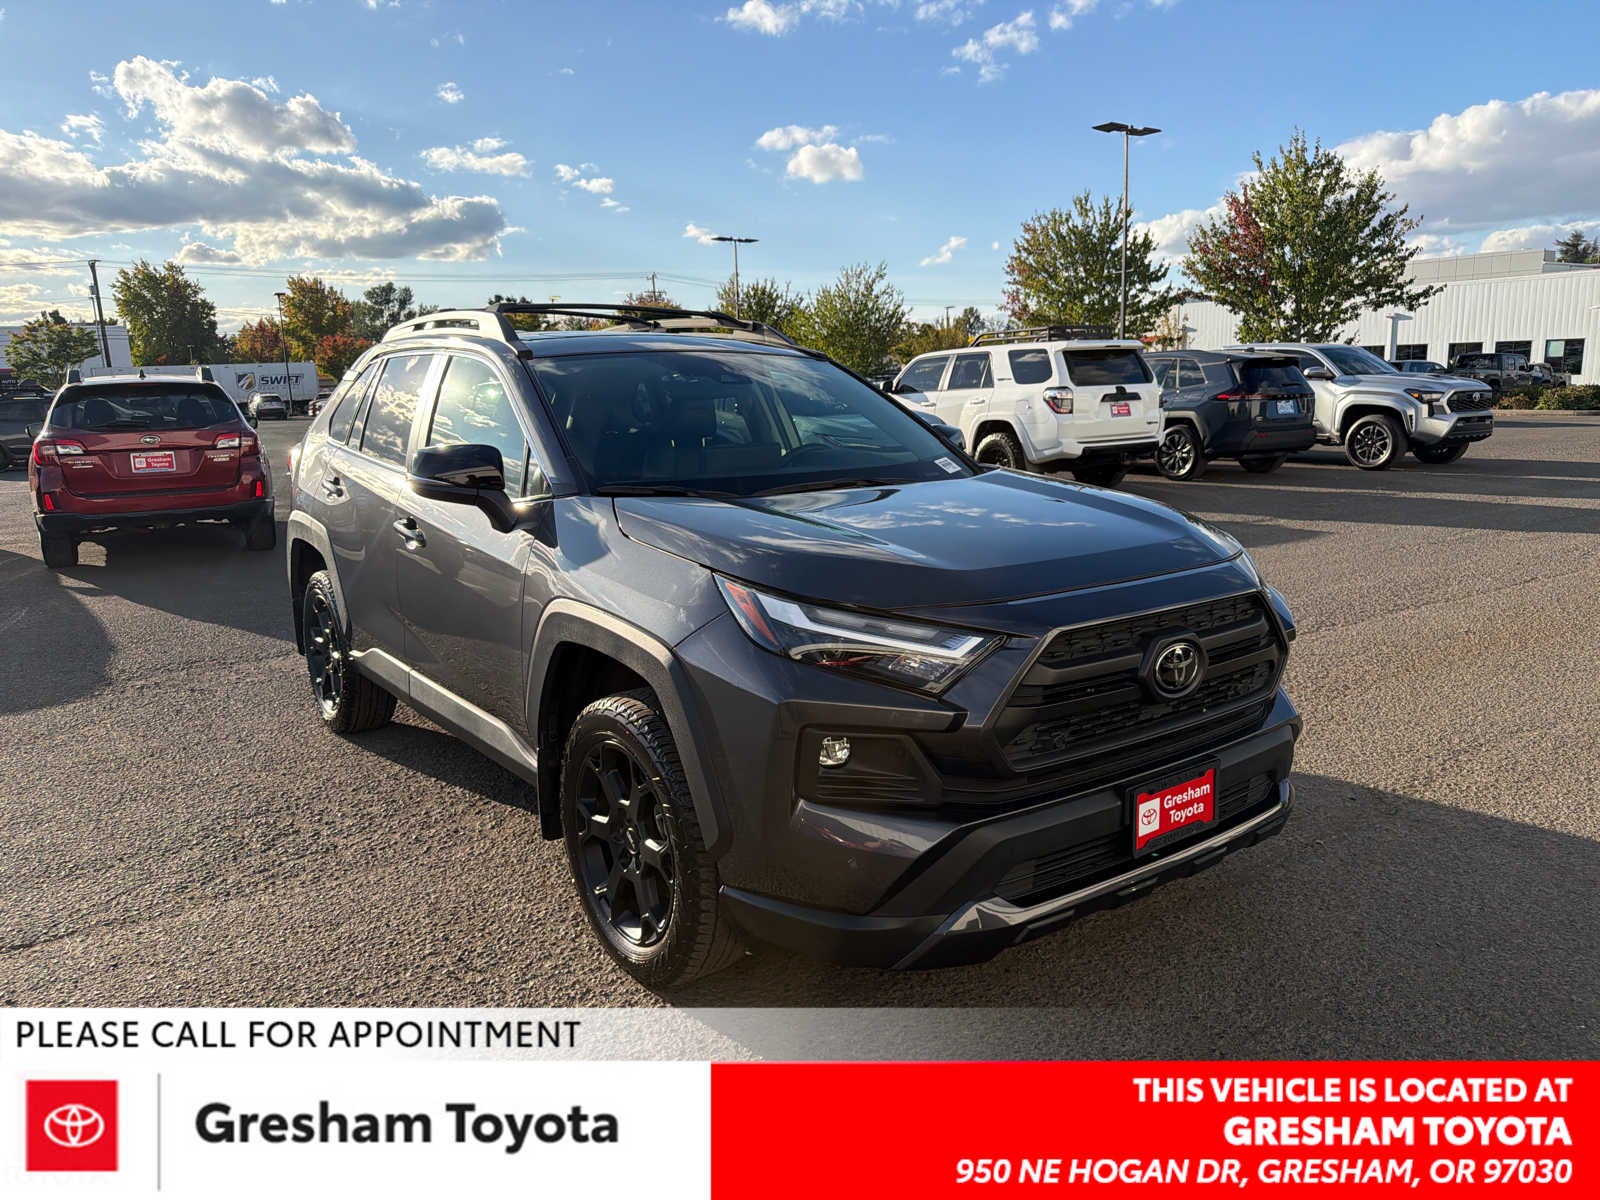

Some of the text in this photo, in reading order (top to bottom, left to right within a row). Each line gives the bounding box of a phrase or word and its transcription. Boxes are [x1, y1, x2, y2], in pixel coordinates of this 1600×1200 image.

[261, 375, 302, 385] SWIFT
[1163, 784, 1210, 808] Gresham
[1168, 802, 1205, 823] Toyota
